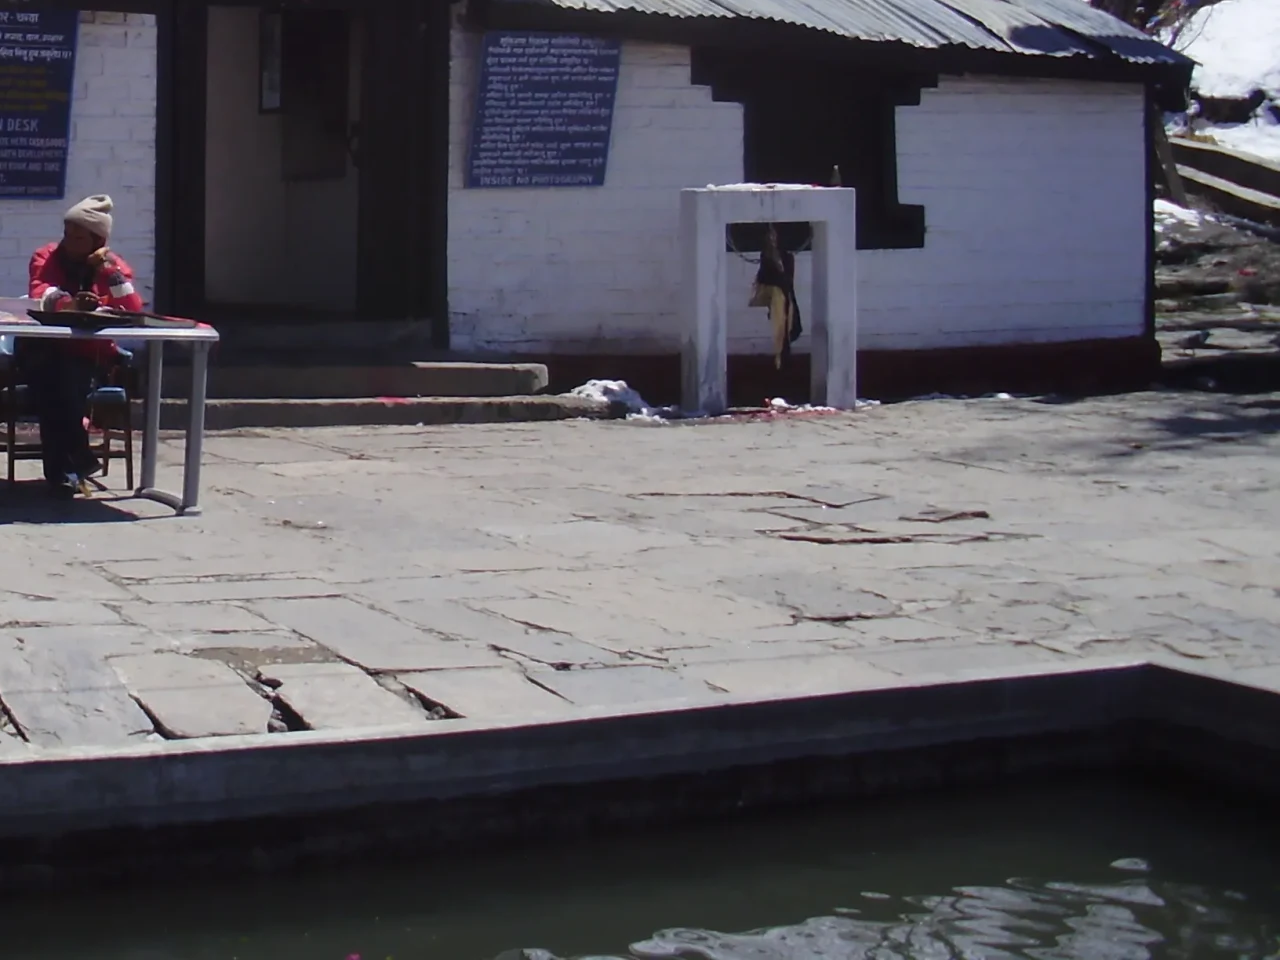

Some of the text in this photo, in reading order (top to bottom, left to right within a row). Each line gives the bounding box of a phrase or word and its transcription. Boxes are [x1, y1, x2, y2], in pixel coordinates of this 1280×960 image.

[7, 118, 39, 132] DESK
[44, 162, 61, 172] TAKE
[480, 175, 593, 186] INSIDE NO PHOTOGRAPHY
